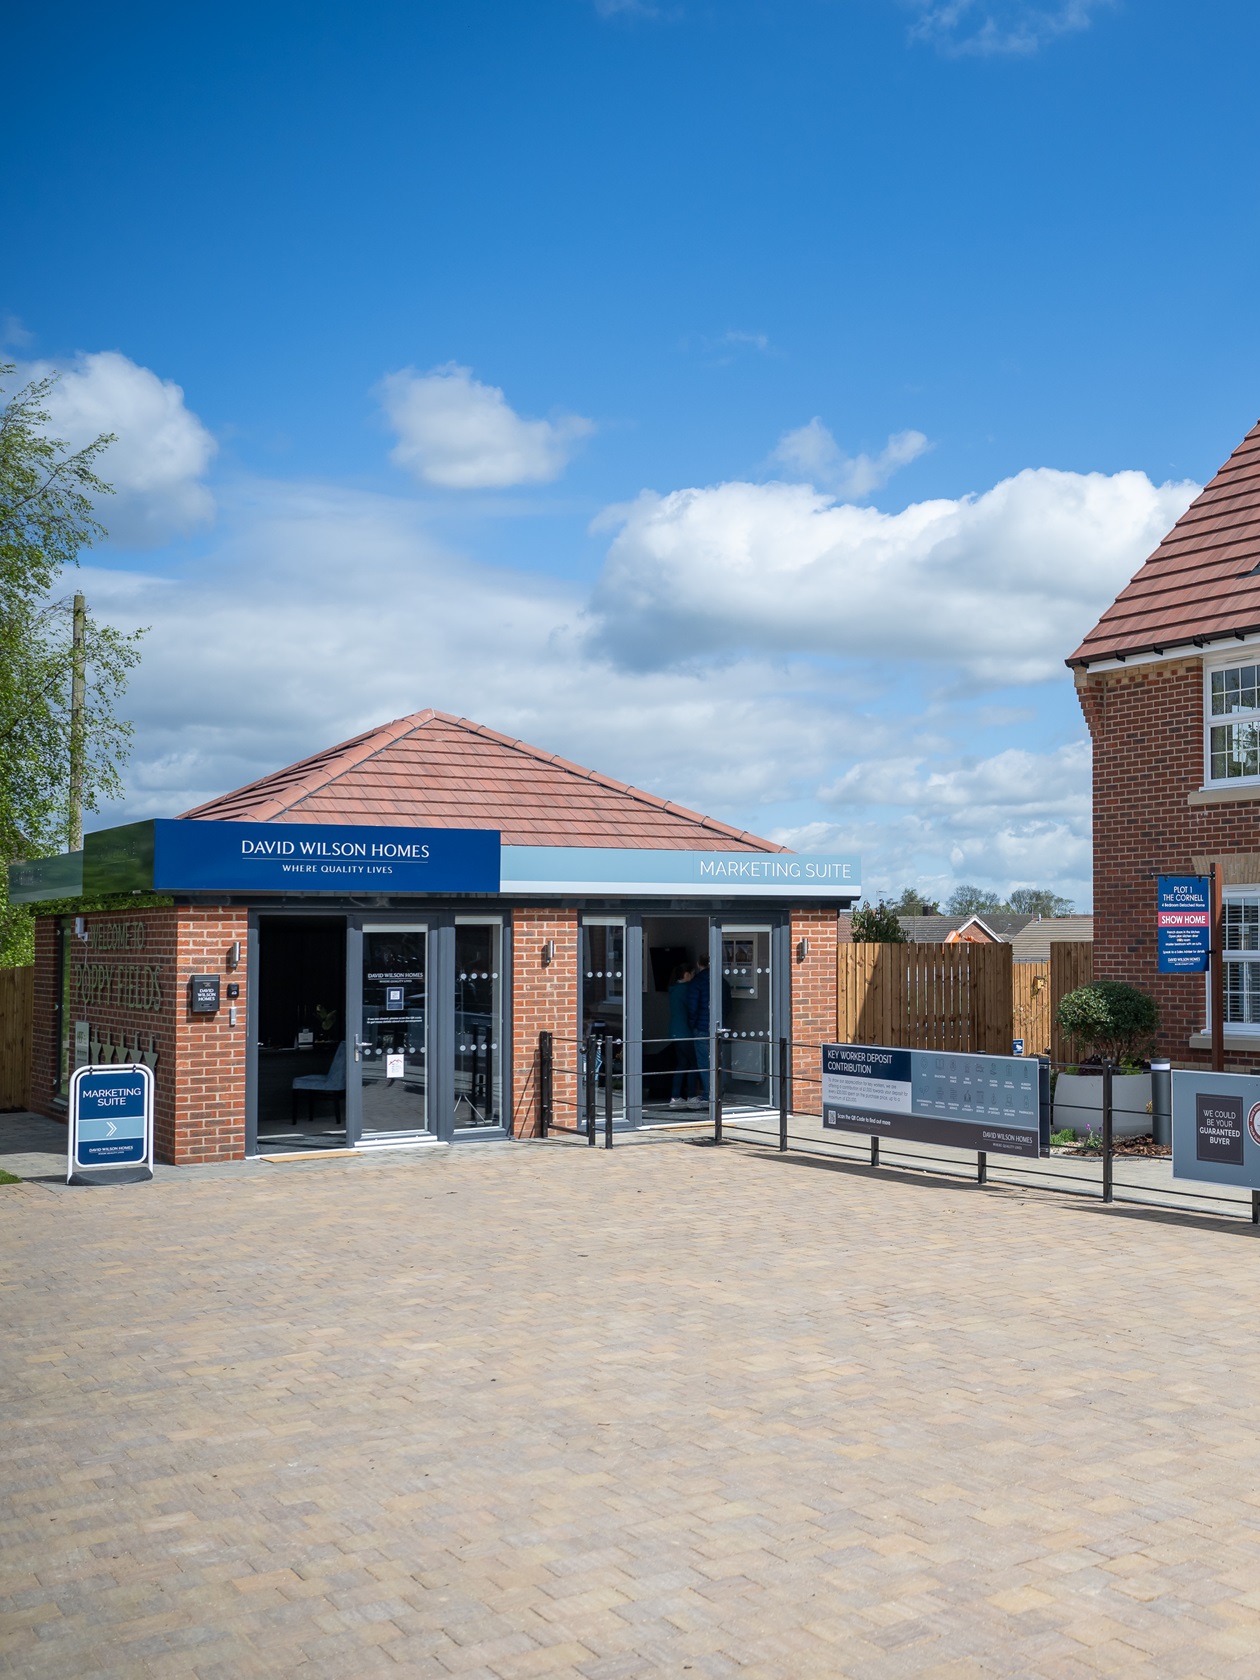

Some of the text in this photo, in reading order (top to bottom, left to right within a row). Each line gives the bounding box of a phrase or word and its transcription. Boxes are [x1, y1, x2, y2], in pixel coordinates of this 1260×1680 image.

[241, 840, 429, 858] DAVID WILSON HOMES
[282, 864, 393, 874] WHERE QUALITY LIVES
[700, 861, 851, 878] MARKETING SUITE
[1175, 894, 1204, 902] CORNELL
[1161, 915, 1206, 924] SHOW HOME
[90, 922, 145, 950] WELCOME TO
[75, 964, 161, 1011] POPPY FIELDS
[828, 1050, 892, 1064] KEY WORKER DEPOSIT
[828, 1062, 872, 1074] CONTRIBUTION
[83, 1088, 141, 1098] MARKETING
[97, 1097, 126, 1106] SUITE
[1203, 1109, 1236, 1119] WE COULD
[1216, 1120, 1232, 1128] YOUR
[1199, 1127, 1240, 1137] GUARANTEED
[983, 1131, 1033, 1144] DAVID WILSON HOMES
[1210, 1137, 1230, 1145] BUYER
